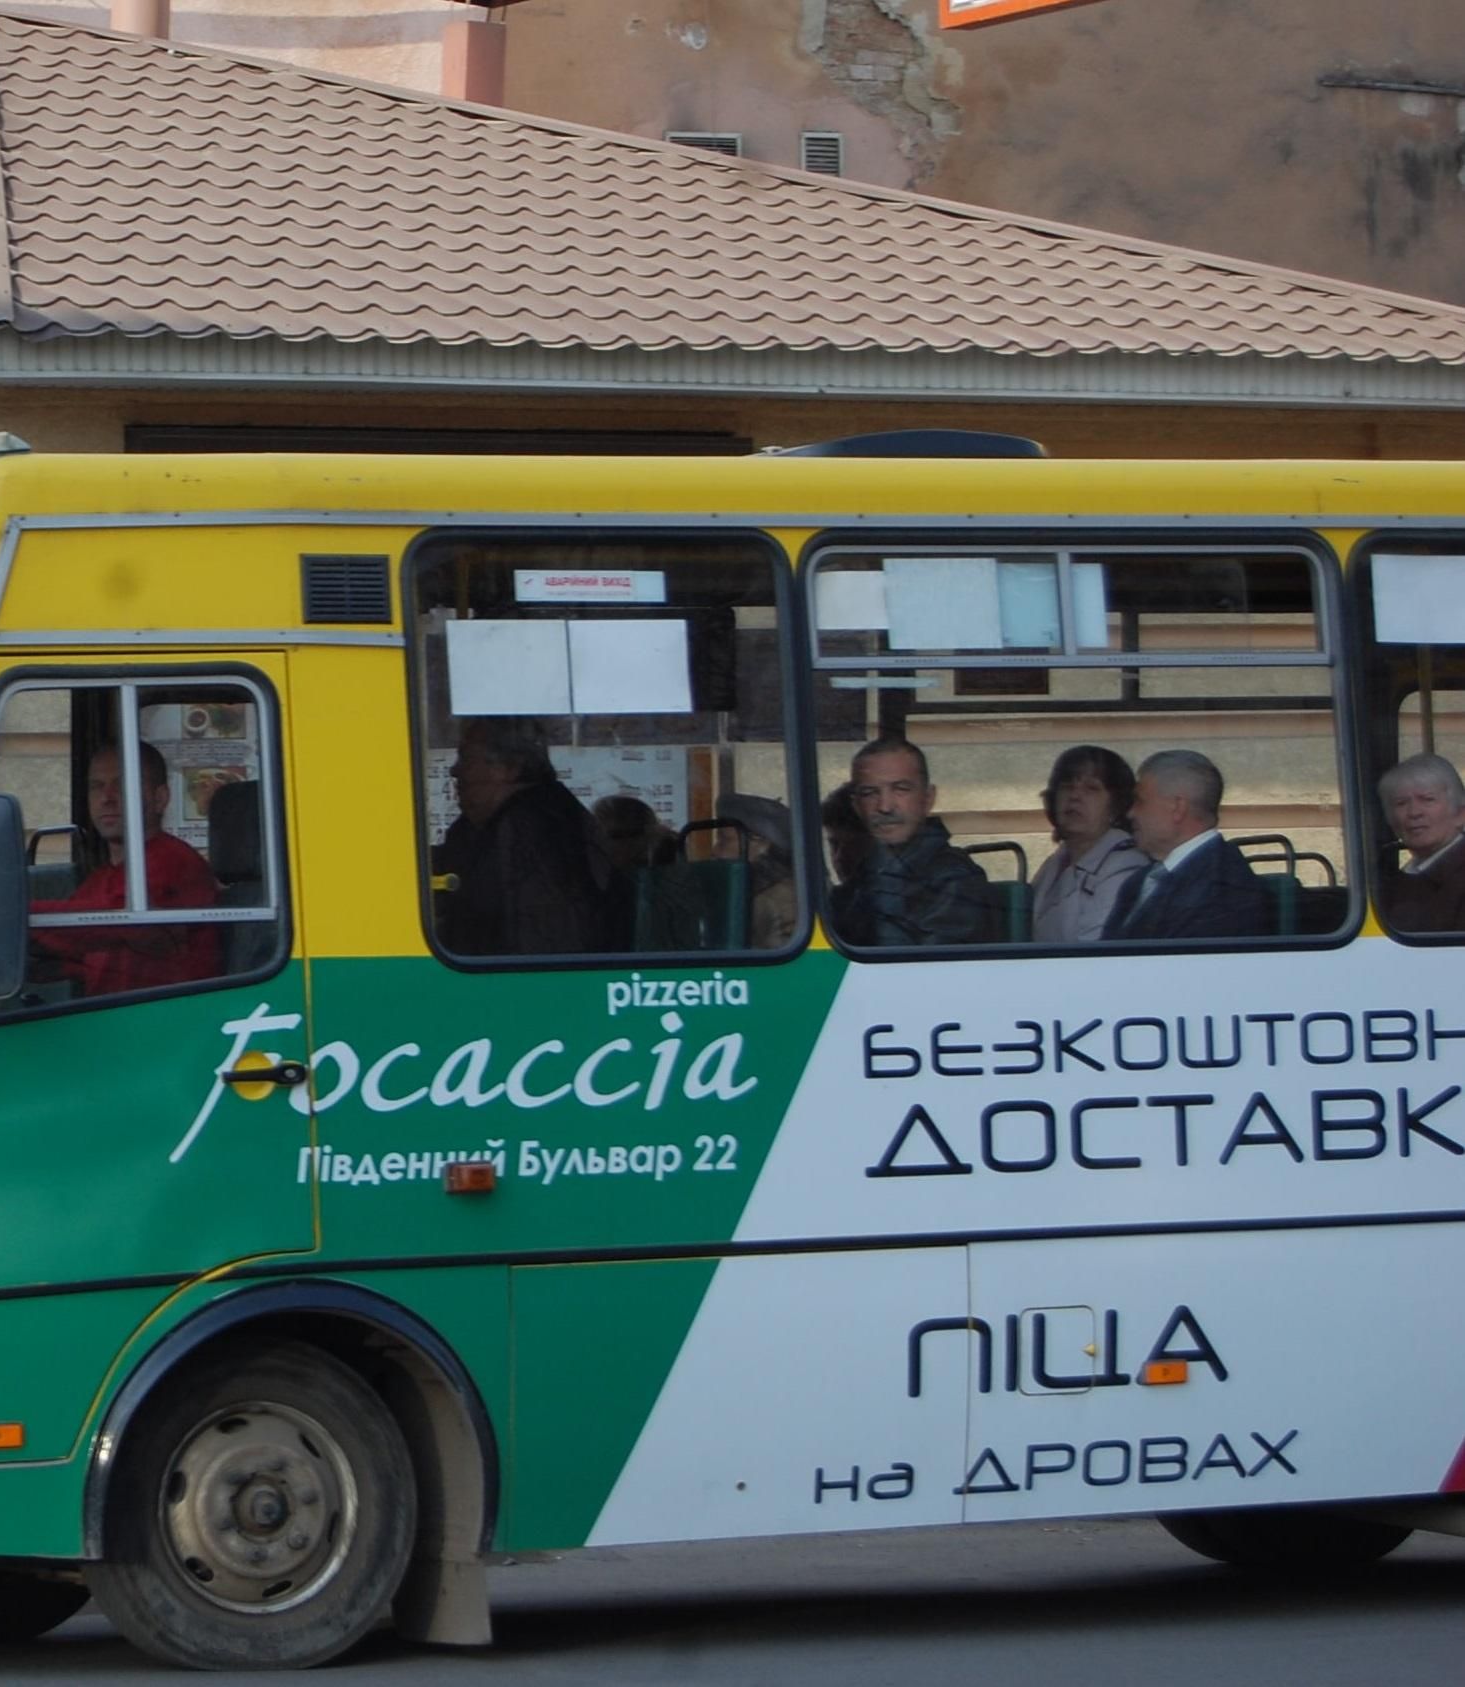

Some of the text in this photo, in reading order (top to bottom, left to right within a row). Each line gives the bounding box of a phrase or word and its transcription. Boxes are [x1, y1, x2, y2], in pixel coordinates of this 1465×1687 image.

[607, 972, 749, 1015] pizzeria
[169, 1002, 758, 1163] Focaccia
[518, 1140, 682, 1185] Бульвар
[692, 1134, 738, 1171] 22
[864, 1084, 1465, 1178] ДОСТАВК
[907, 1304, 1229, 1398] ПІЦА
[952, 1429, 1299, 1497] ДРОВАХ
